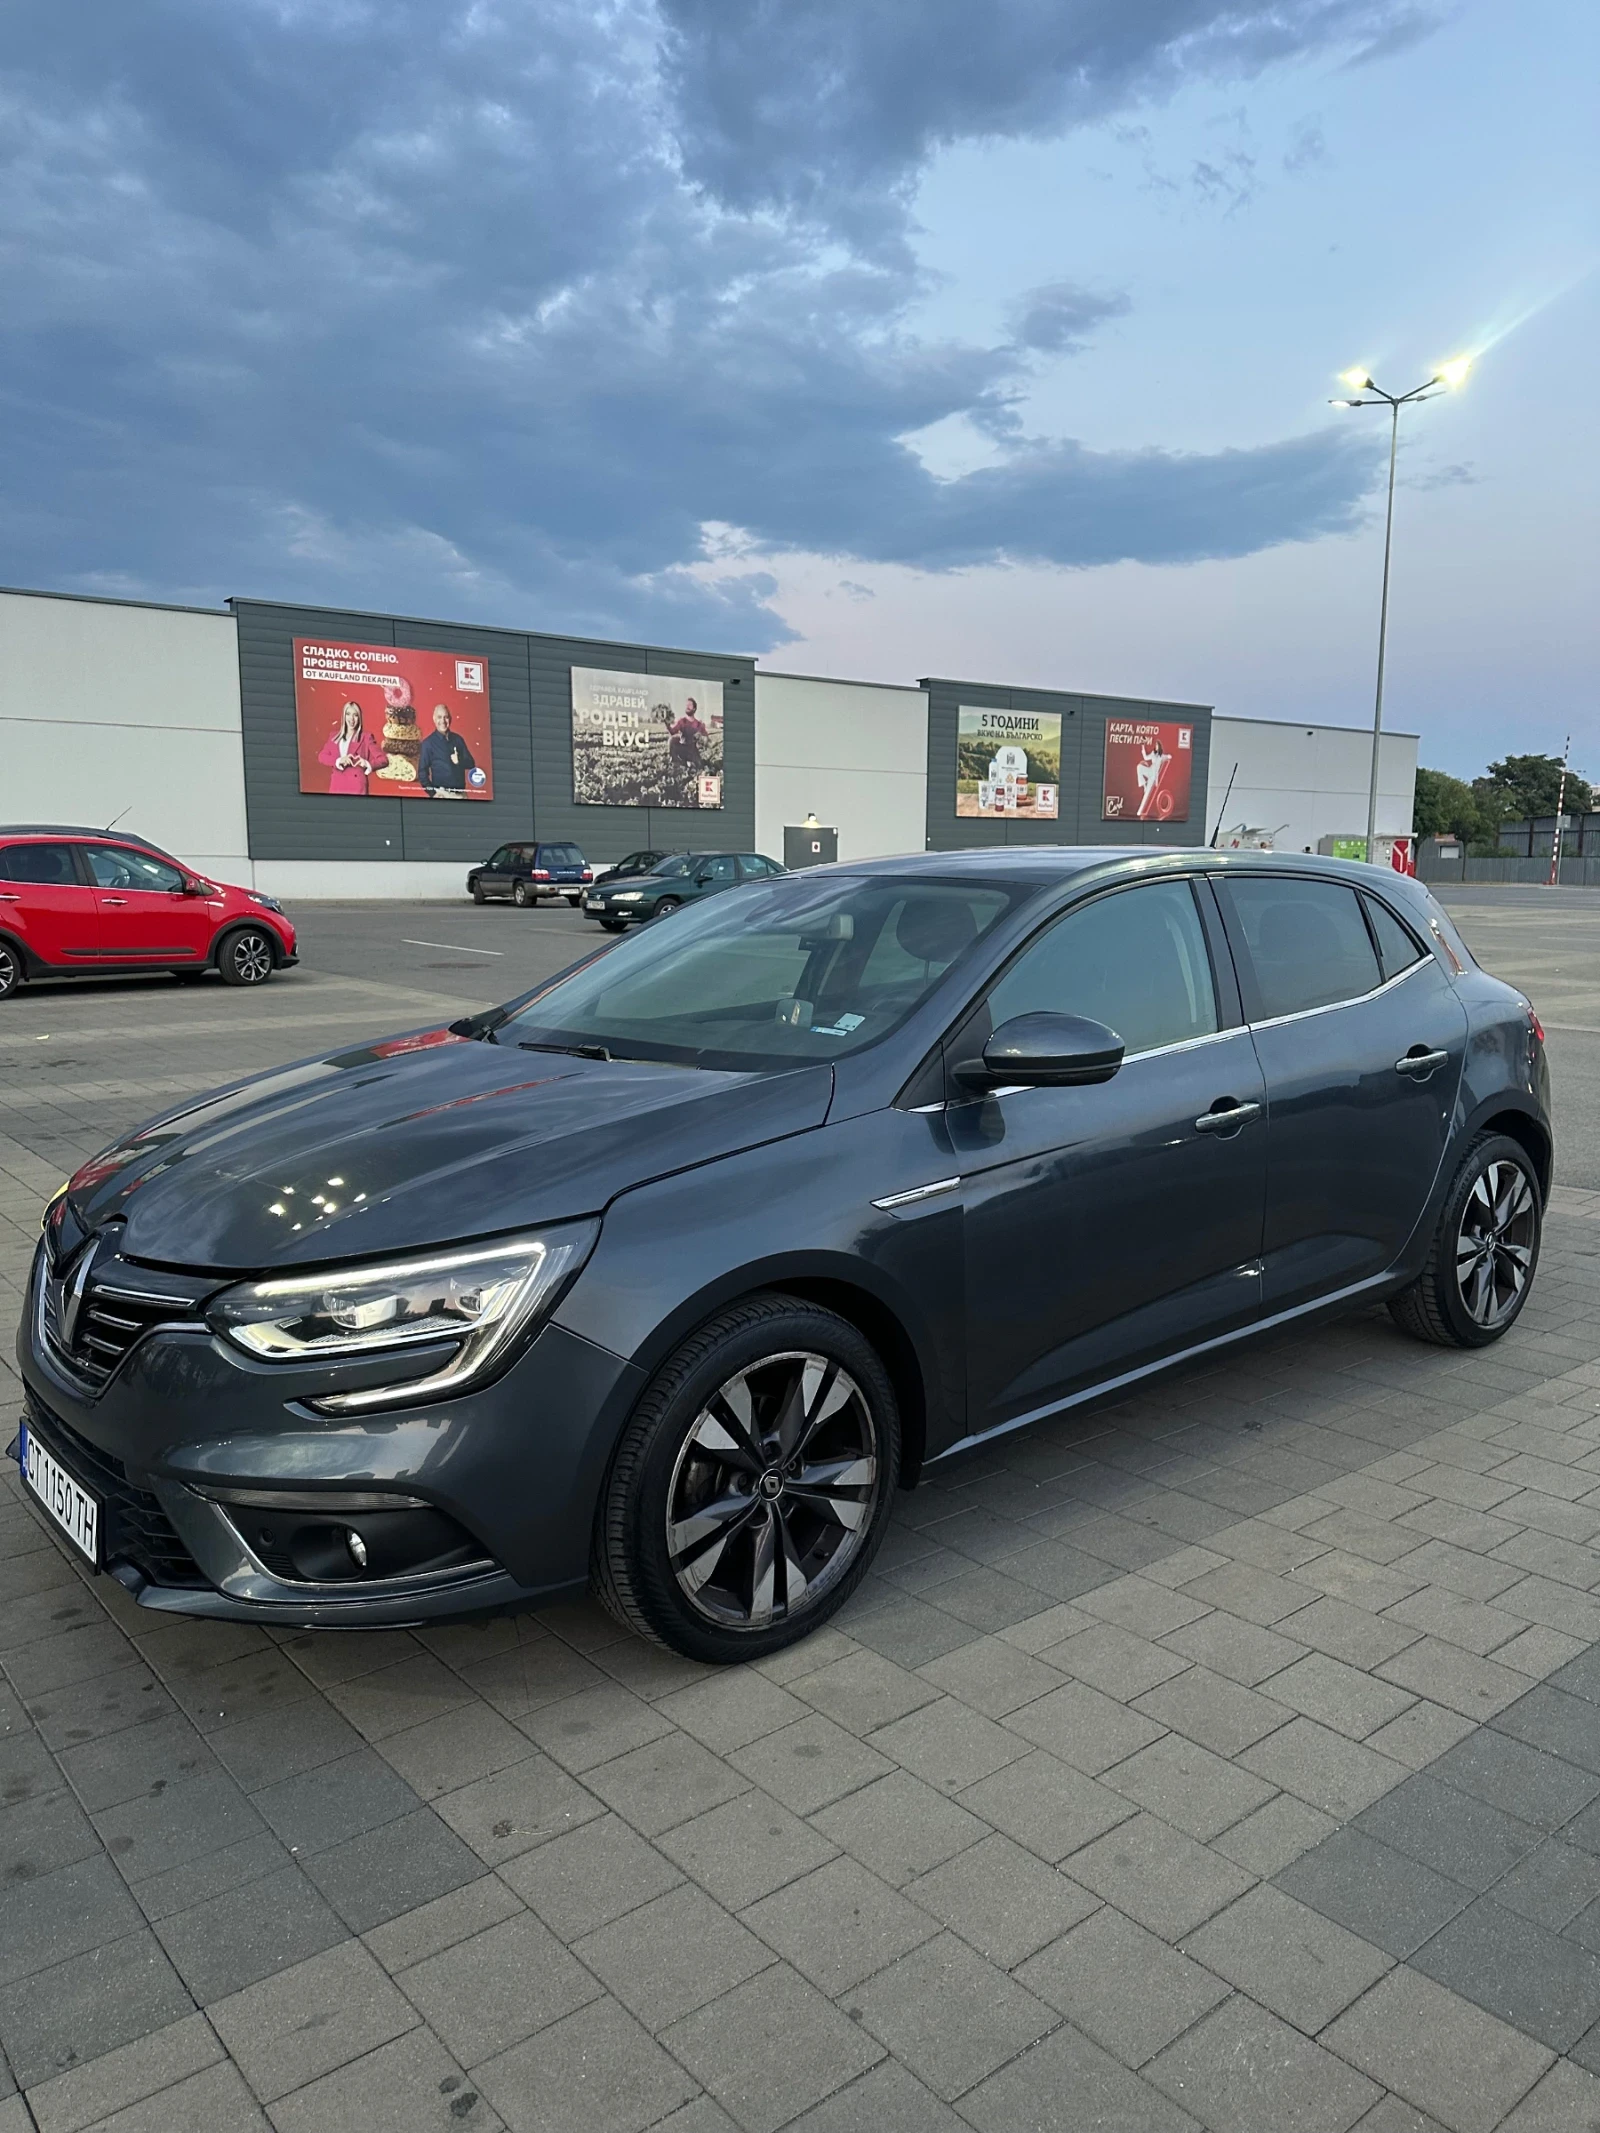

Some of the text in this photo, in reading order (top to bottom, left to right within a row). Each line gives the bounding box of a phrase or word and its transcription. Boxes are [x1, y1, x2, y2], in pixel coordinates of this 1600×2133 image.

[302, 645, 399, 664] СЛАДКО. СОЛЕНО.
[303, 657, 370, 672] ПРОВЕРЕНО.
[305, 670, 398, 685] ОТ KAUFLAND ПЕКАРНА
[592, 693, 648, 711] ЗДРАВЕЙ,
[578, 708, 639, 729] РОДЕН
[981, 714, 1039, 731] 5 ГОДИНИ
[977, 729, 1043, 741] ВКУС НА БЪЛГАРСКО
[1110, 723, 1159, 735] КАРТА, КОЯТО
[602, 729, 650, 748] ВКУС!
[1109, 734, 1132, 744] ПЕСТИ
[45, 1458, 73, 1526] 1150
